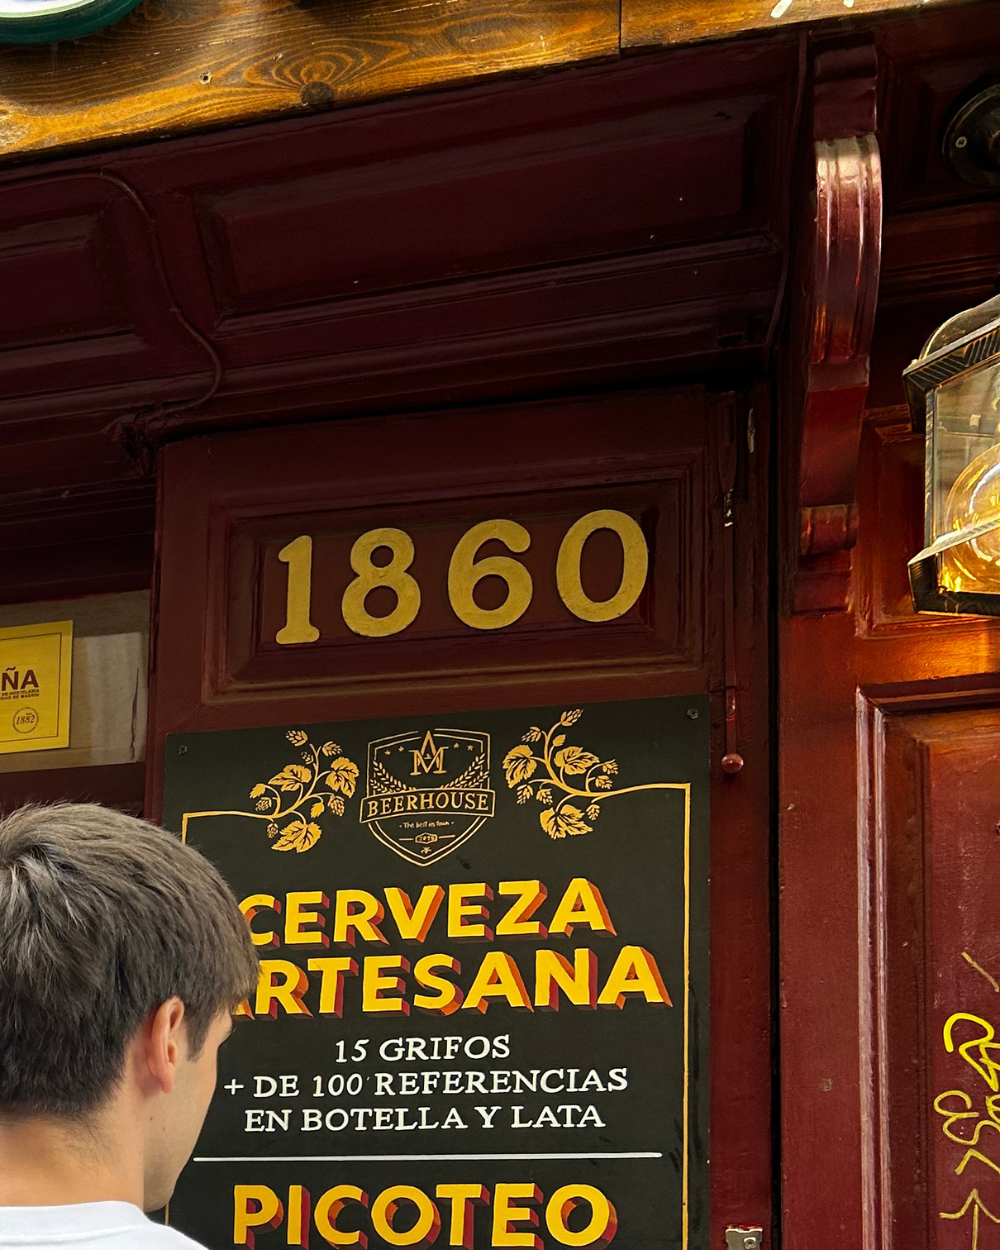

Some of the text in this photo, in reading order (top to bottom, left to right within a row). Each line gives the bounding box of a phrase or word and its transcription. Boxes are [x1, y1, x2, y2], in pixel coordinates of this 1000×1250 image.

[276, 509, 649, 645] 1860
[15, 714, 36, 725] 1882
[367, 792, 489, 818] BEERHOUSE
[238, 878, 616, 950] CERVEZA
[232, 945, 673, 1021] RTESANA
[335, 1034, 511, 1063] 15 GRIFOS
[253, 1074, 299, 1098] DE
[312, 1073, 363, 1097] 100
[373, 1067, 629, 1096] REFERENCIAS
[244, 1103, 607, 1133] EN BOTELLA Y LATA
